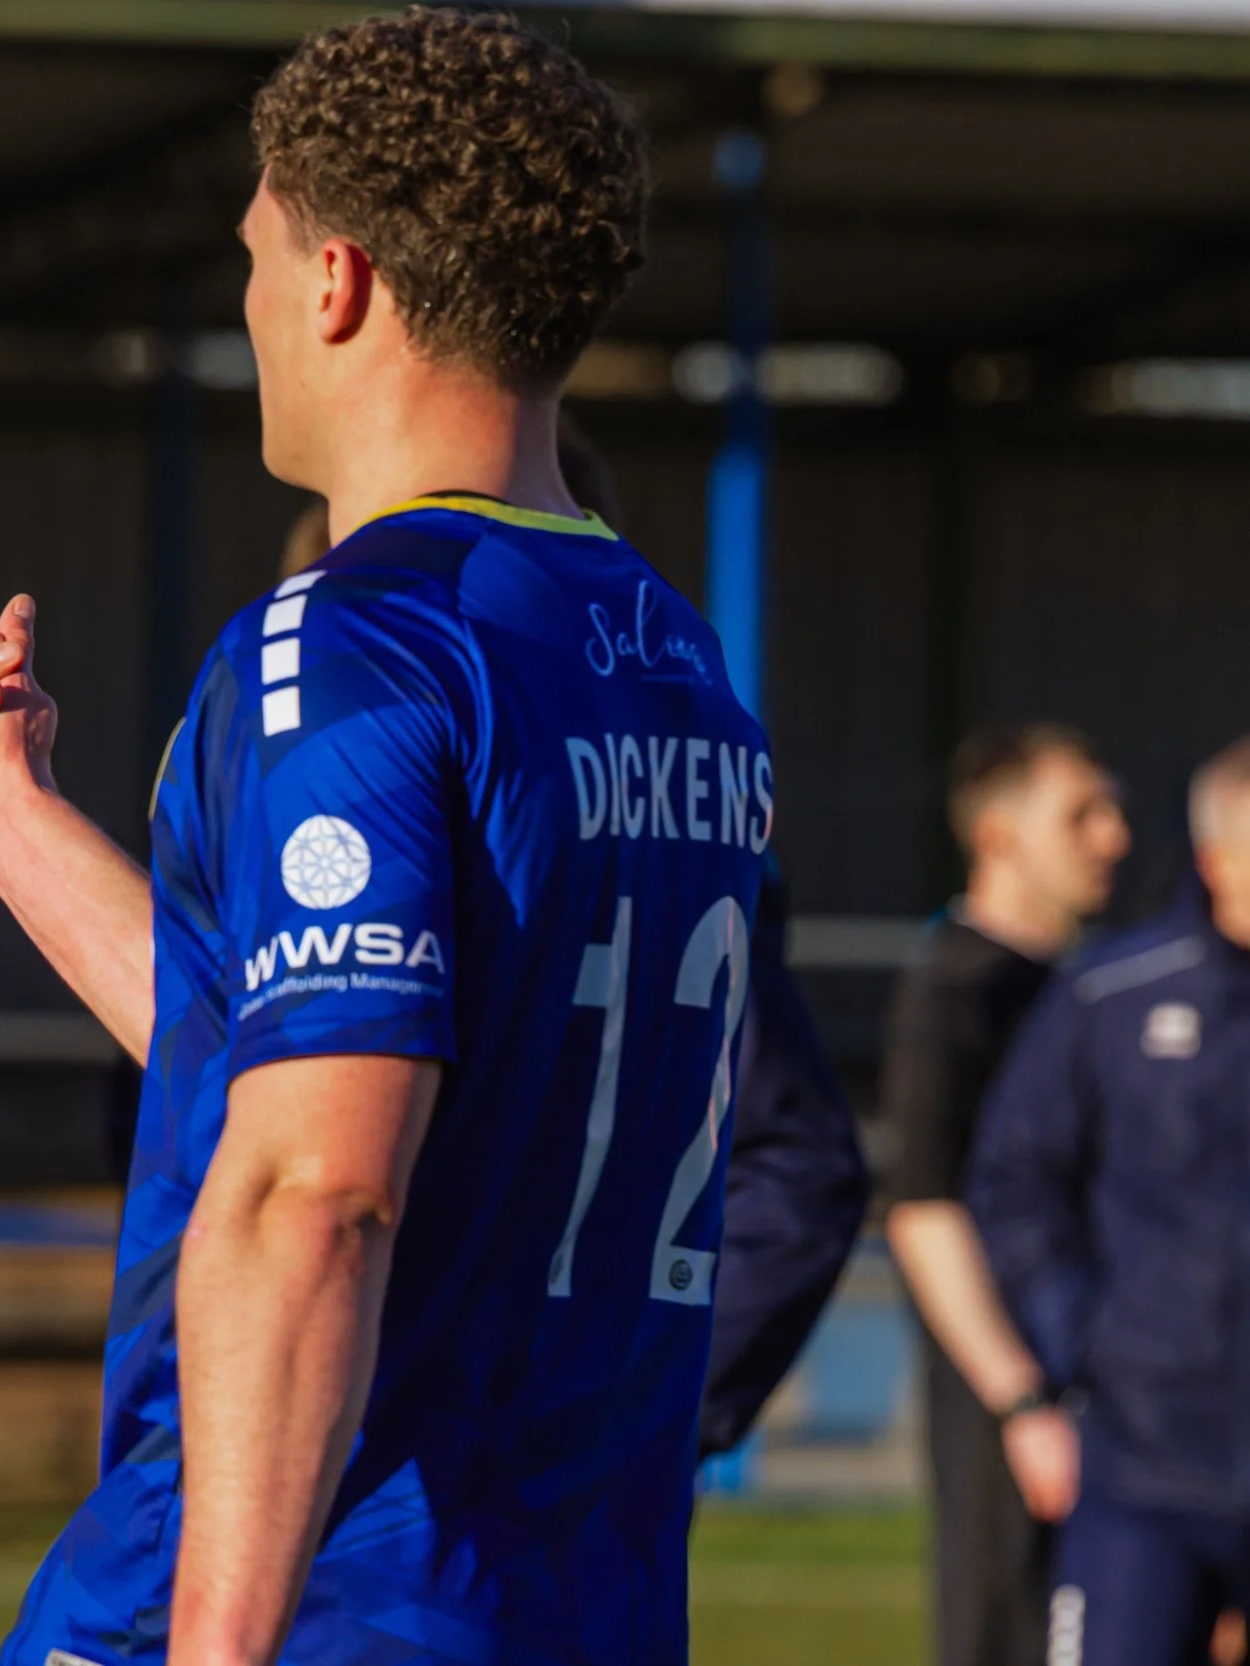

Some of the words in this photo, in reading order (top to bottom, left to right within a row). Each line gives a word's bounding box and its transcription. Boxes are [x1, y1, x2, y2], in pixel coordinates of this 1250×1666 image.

[565, 732, 773, 855] DICKENS
[244, 922, 446, 992] WWSA
[547, 896, 748, 1306] 12
